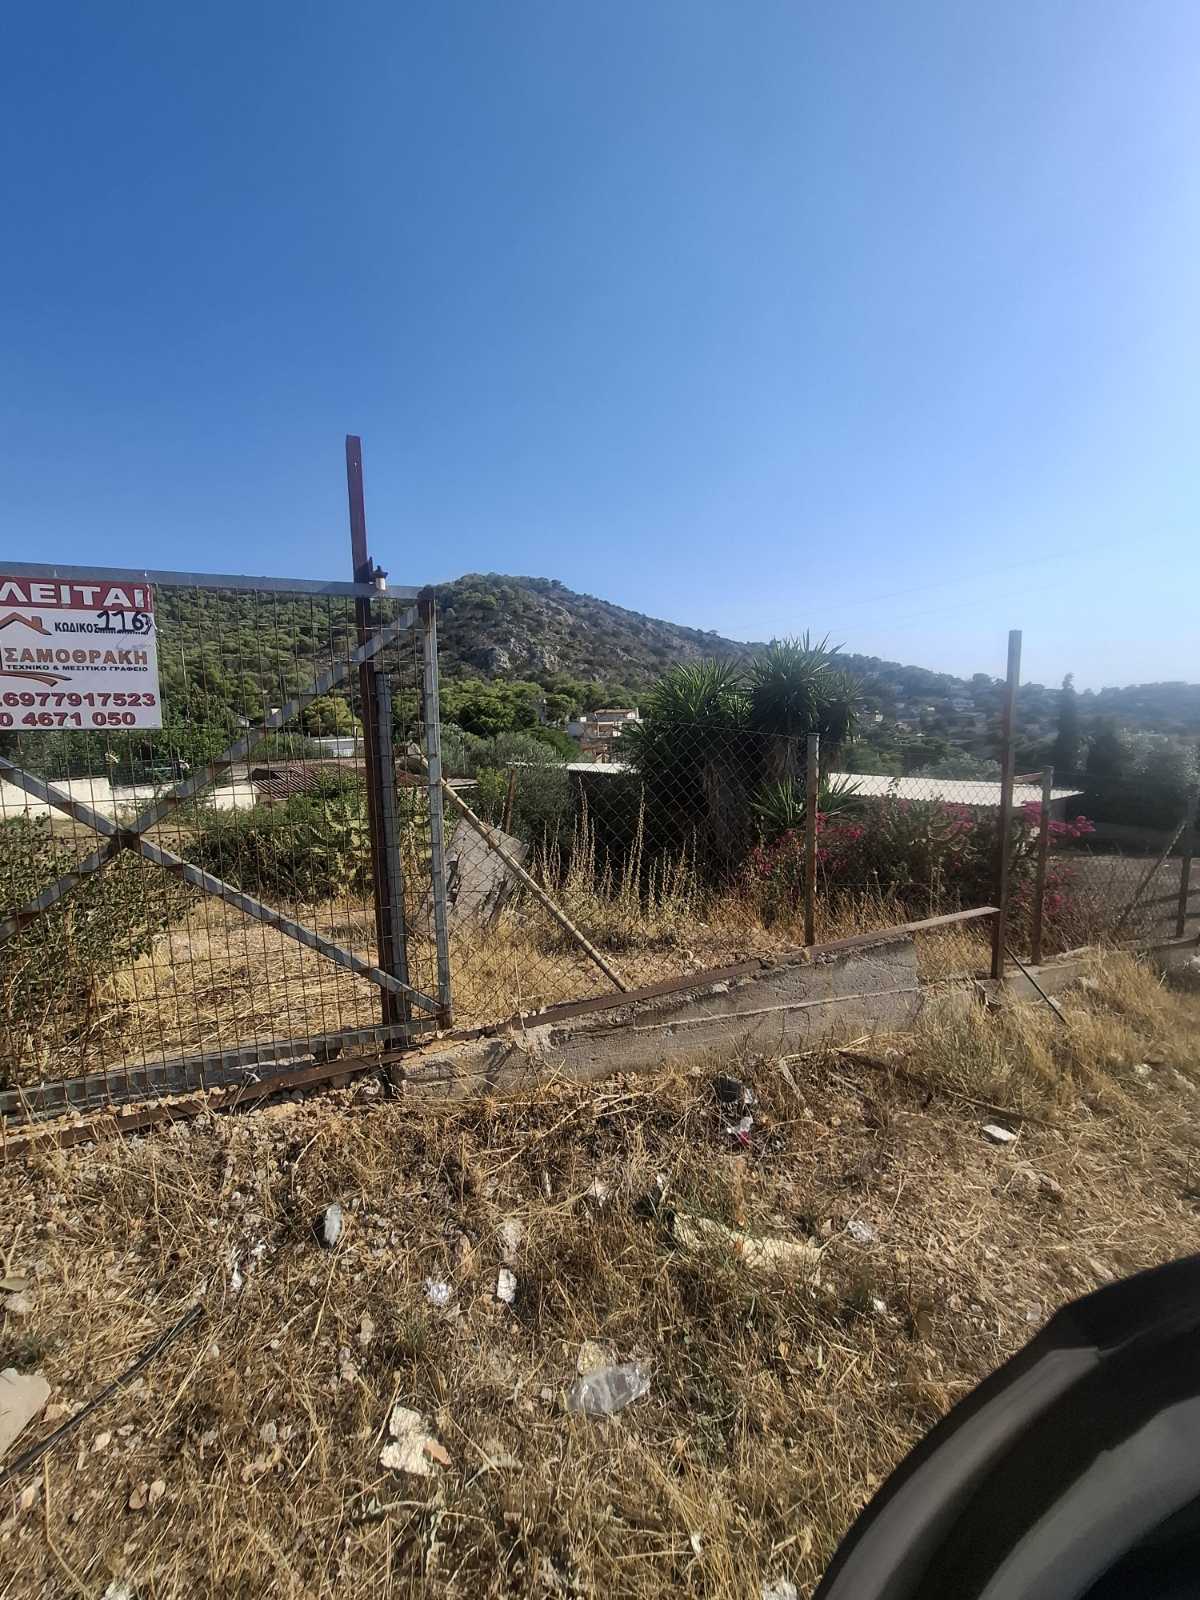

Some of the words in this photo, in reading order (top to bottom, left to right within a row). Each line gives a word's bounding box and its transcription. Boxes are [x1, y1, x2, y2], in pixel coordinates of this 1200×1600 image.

[0, 581, 145, 608] ΛΕΙΤΑΙ
[3, 647, 148, 665] ΣΑΜΟΘΡΑΚΗ
[22, 712, 82, 727] 4671
[92, 712, 136, 726] 050
